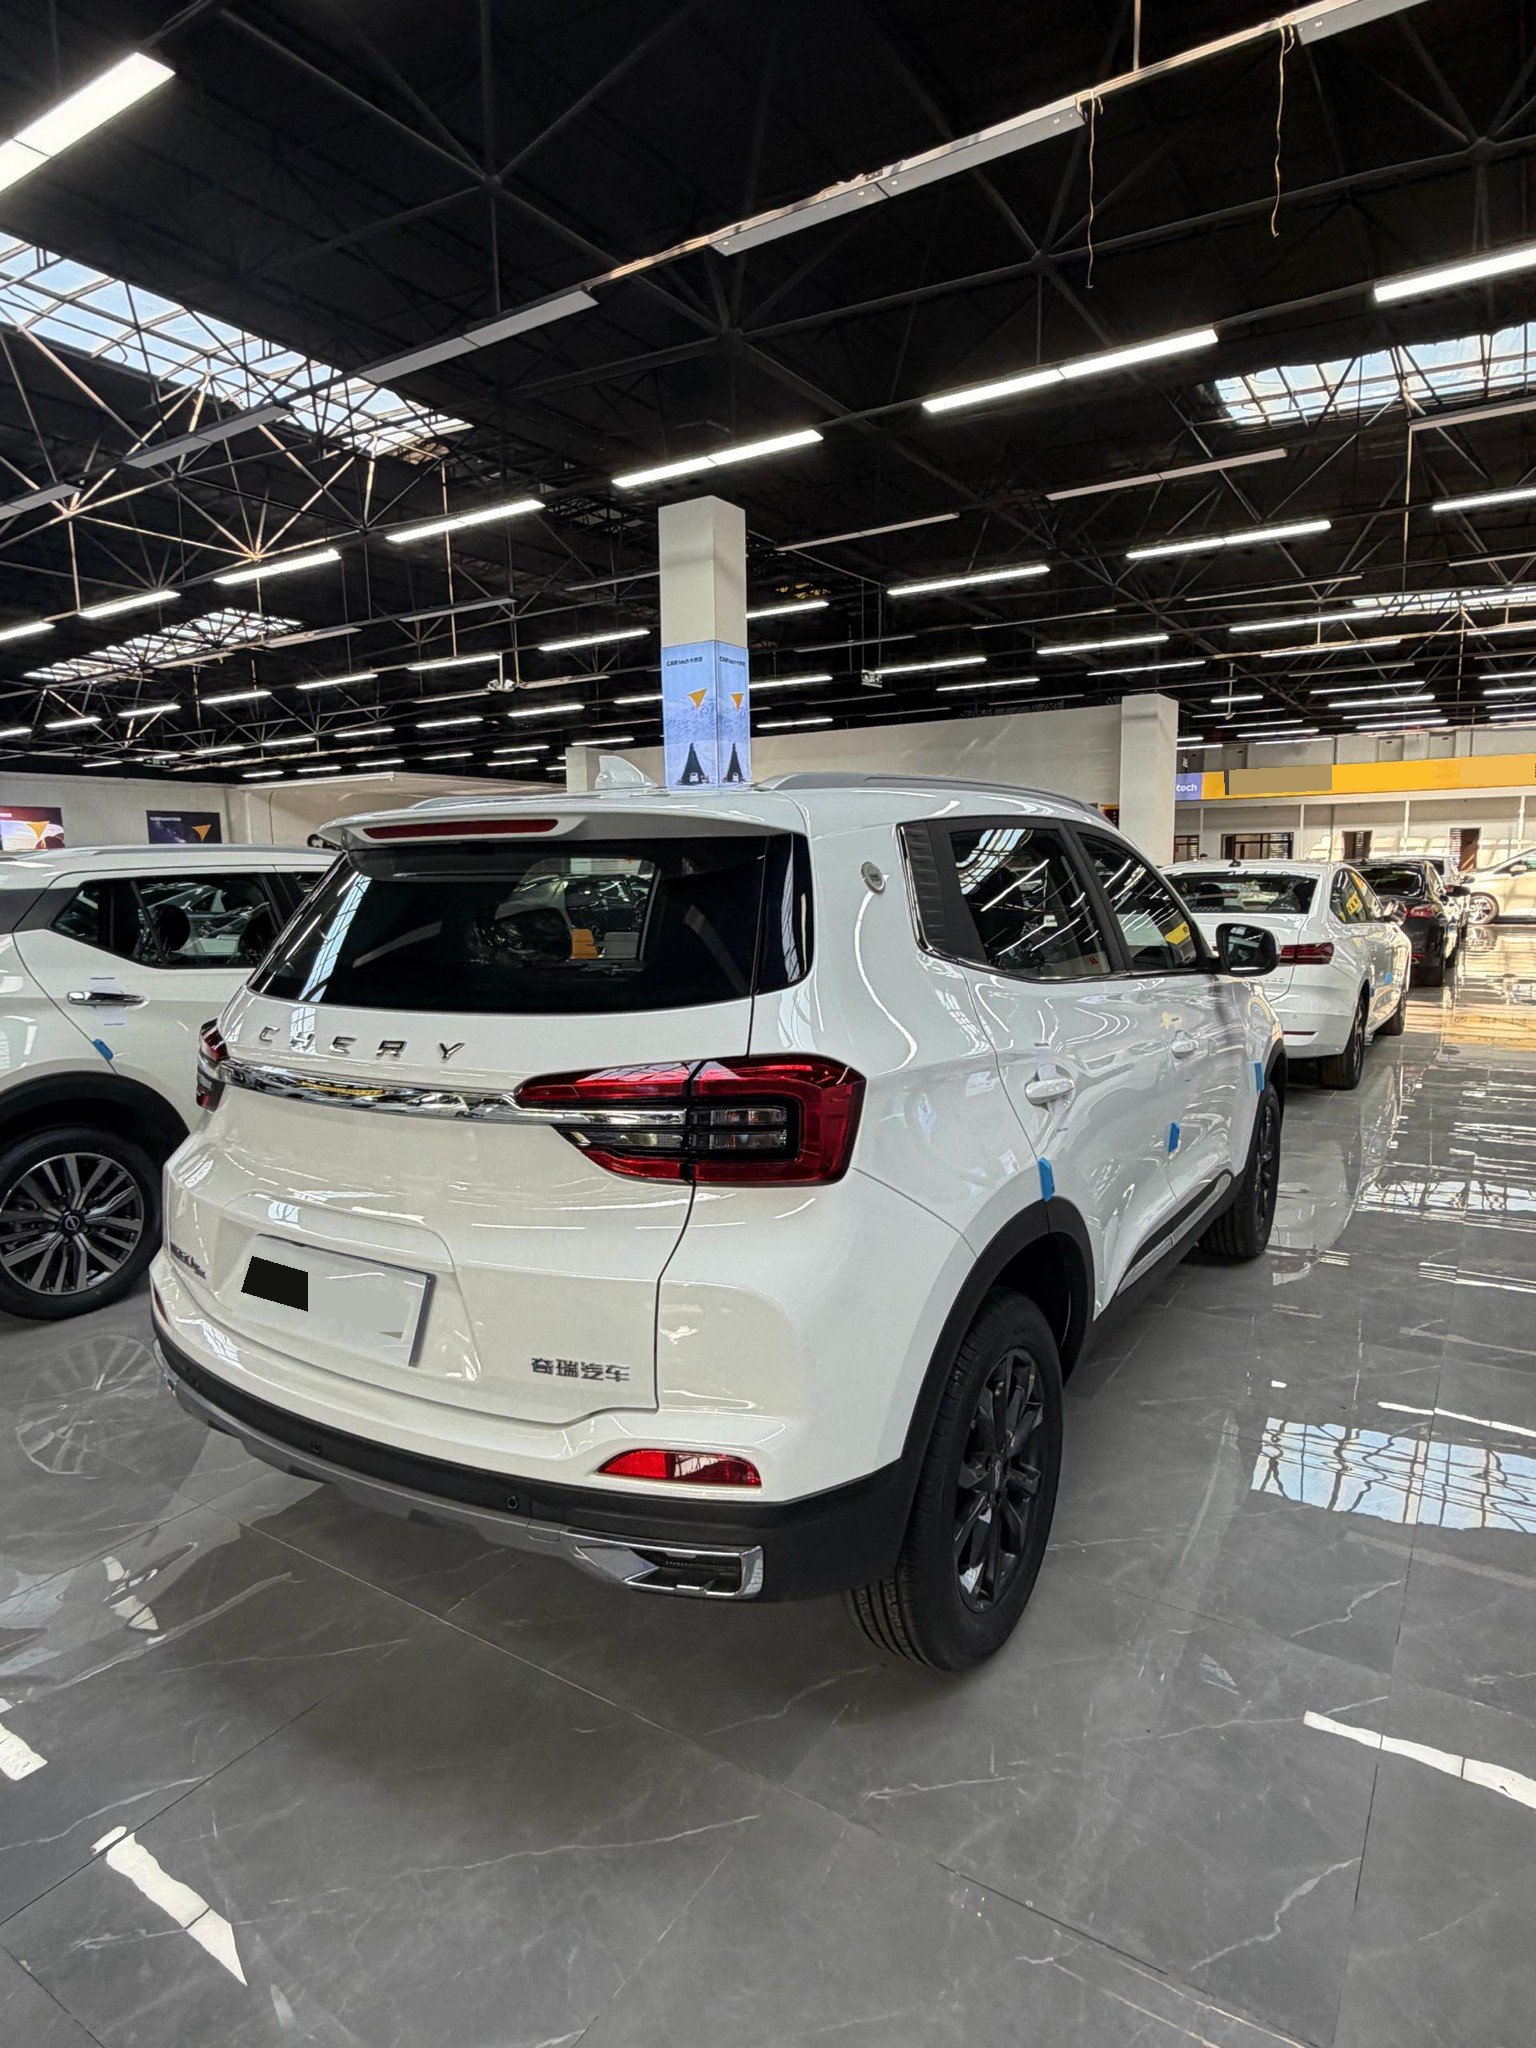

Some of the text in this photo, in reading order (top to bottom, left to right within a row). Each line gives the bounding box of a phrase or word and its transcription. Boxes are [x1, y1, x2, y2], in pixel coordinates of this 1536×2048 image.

[258, 1025, 465, 1060] CHERY
[531, 1357, 630, 1382] 奇瑞汽车
